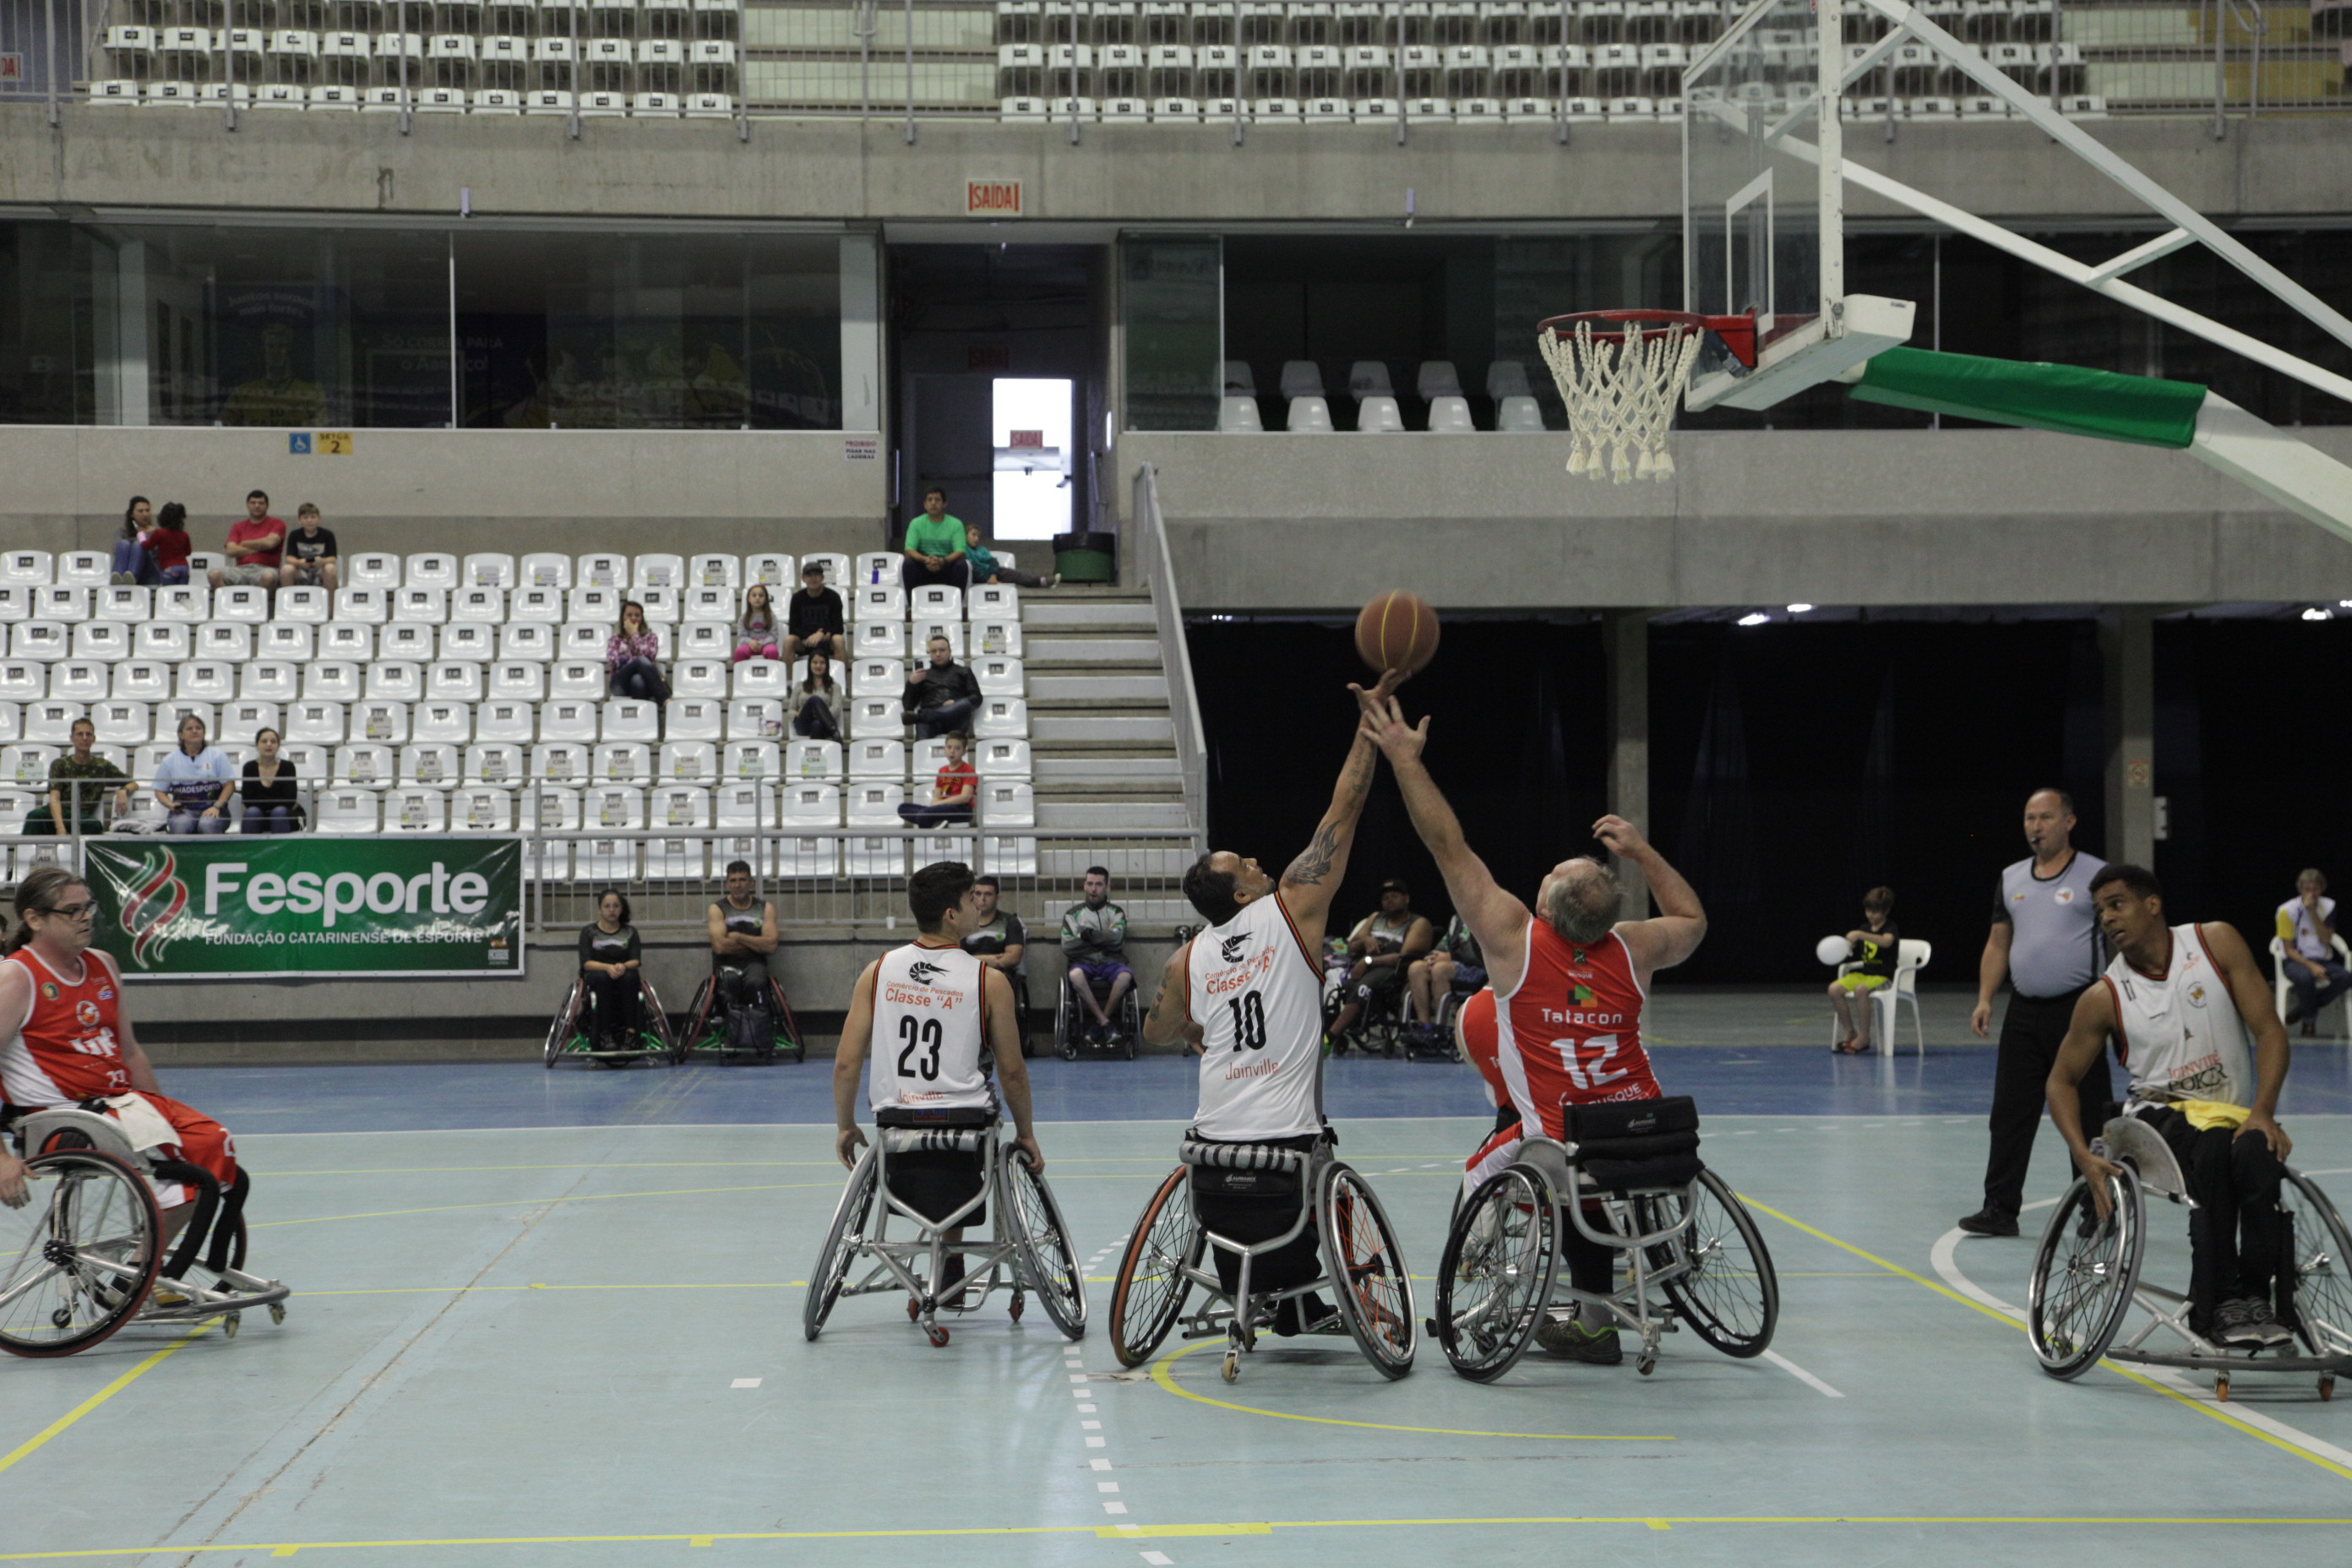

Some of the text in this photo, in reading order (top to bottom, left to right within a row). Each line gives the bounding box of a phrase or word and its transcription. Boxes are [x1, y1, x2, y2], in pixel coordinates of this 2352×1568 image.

[330, 440, 340, 454] 2
[204, 862, 488, 928] Fesporte
[205, 930, 482, 947] FUNDAÇÃO CATARINENSE DE ESPORTE
[885, 988, 931, 1006] Classe
[887, 981, 918, 992] Comércio
[931, 987, 963, 997] Pescados
[1228, 990, 1266, 1052] 10
[1542, 1008, 1622, 1024] Tatacon
[898, 1015, 942, 1081] 23
[1225, 1058, 1278, 1080] Joinville
[1549, 1033, 1628, 1090] 12
[897, 1088, 943, 1103] Joinville
